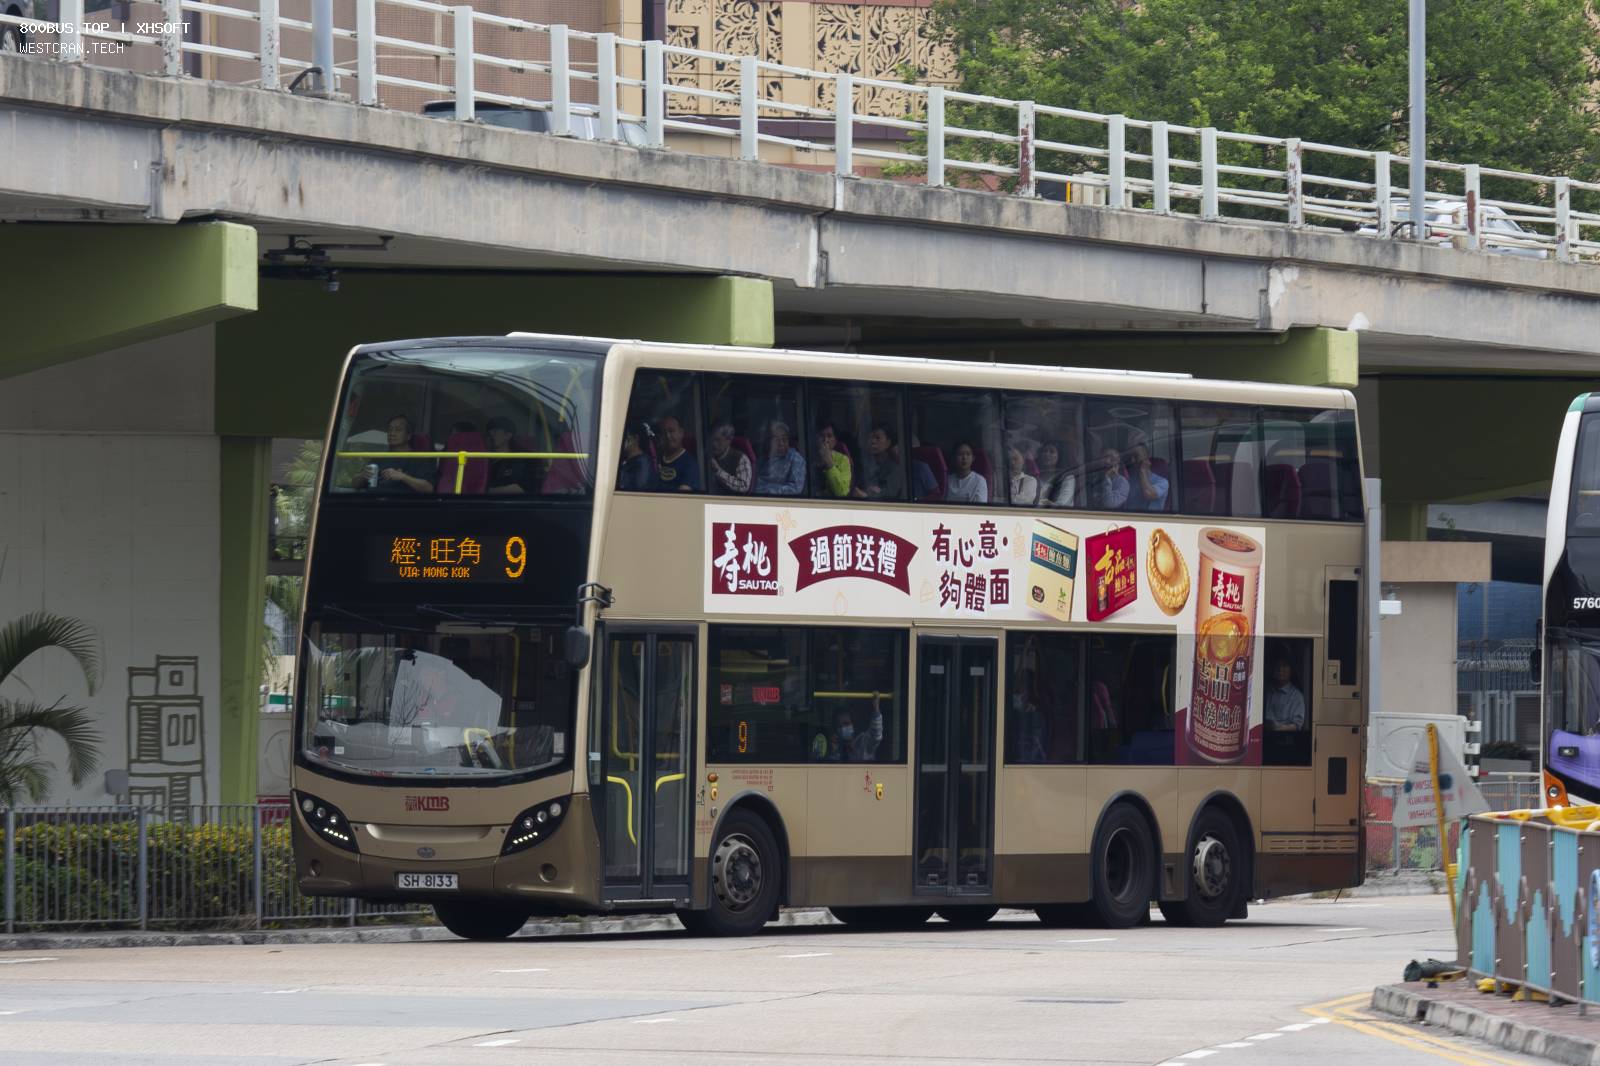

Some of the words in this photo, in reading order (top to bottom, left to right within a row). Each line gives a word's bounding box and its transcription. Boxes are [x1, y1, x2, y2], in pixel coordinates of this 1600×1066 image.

[505, 536, 527, 578] 9
[810, 533, 898, 577] 過節送禮
[399, 567, 420, 577] VIA:
[423, 567, 449, 577] MONG
[451, 567, 470, 577] KOK
[738, 579, 779, 591] SAUTAO
[938, 569, 1010, 612] 夠體面
[738, 721, 747, 753] 9
[416, 795, 450, 811] KMB
[403, 875, 420, 887] SH
[424, 875, 453, 888] 8133
